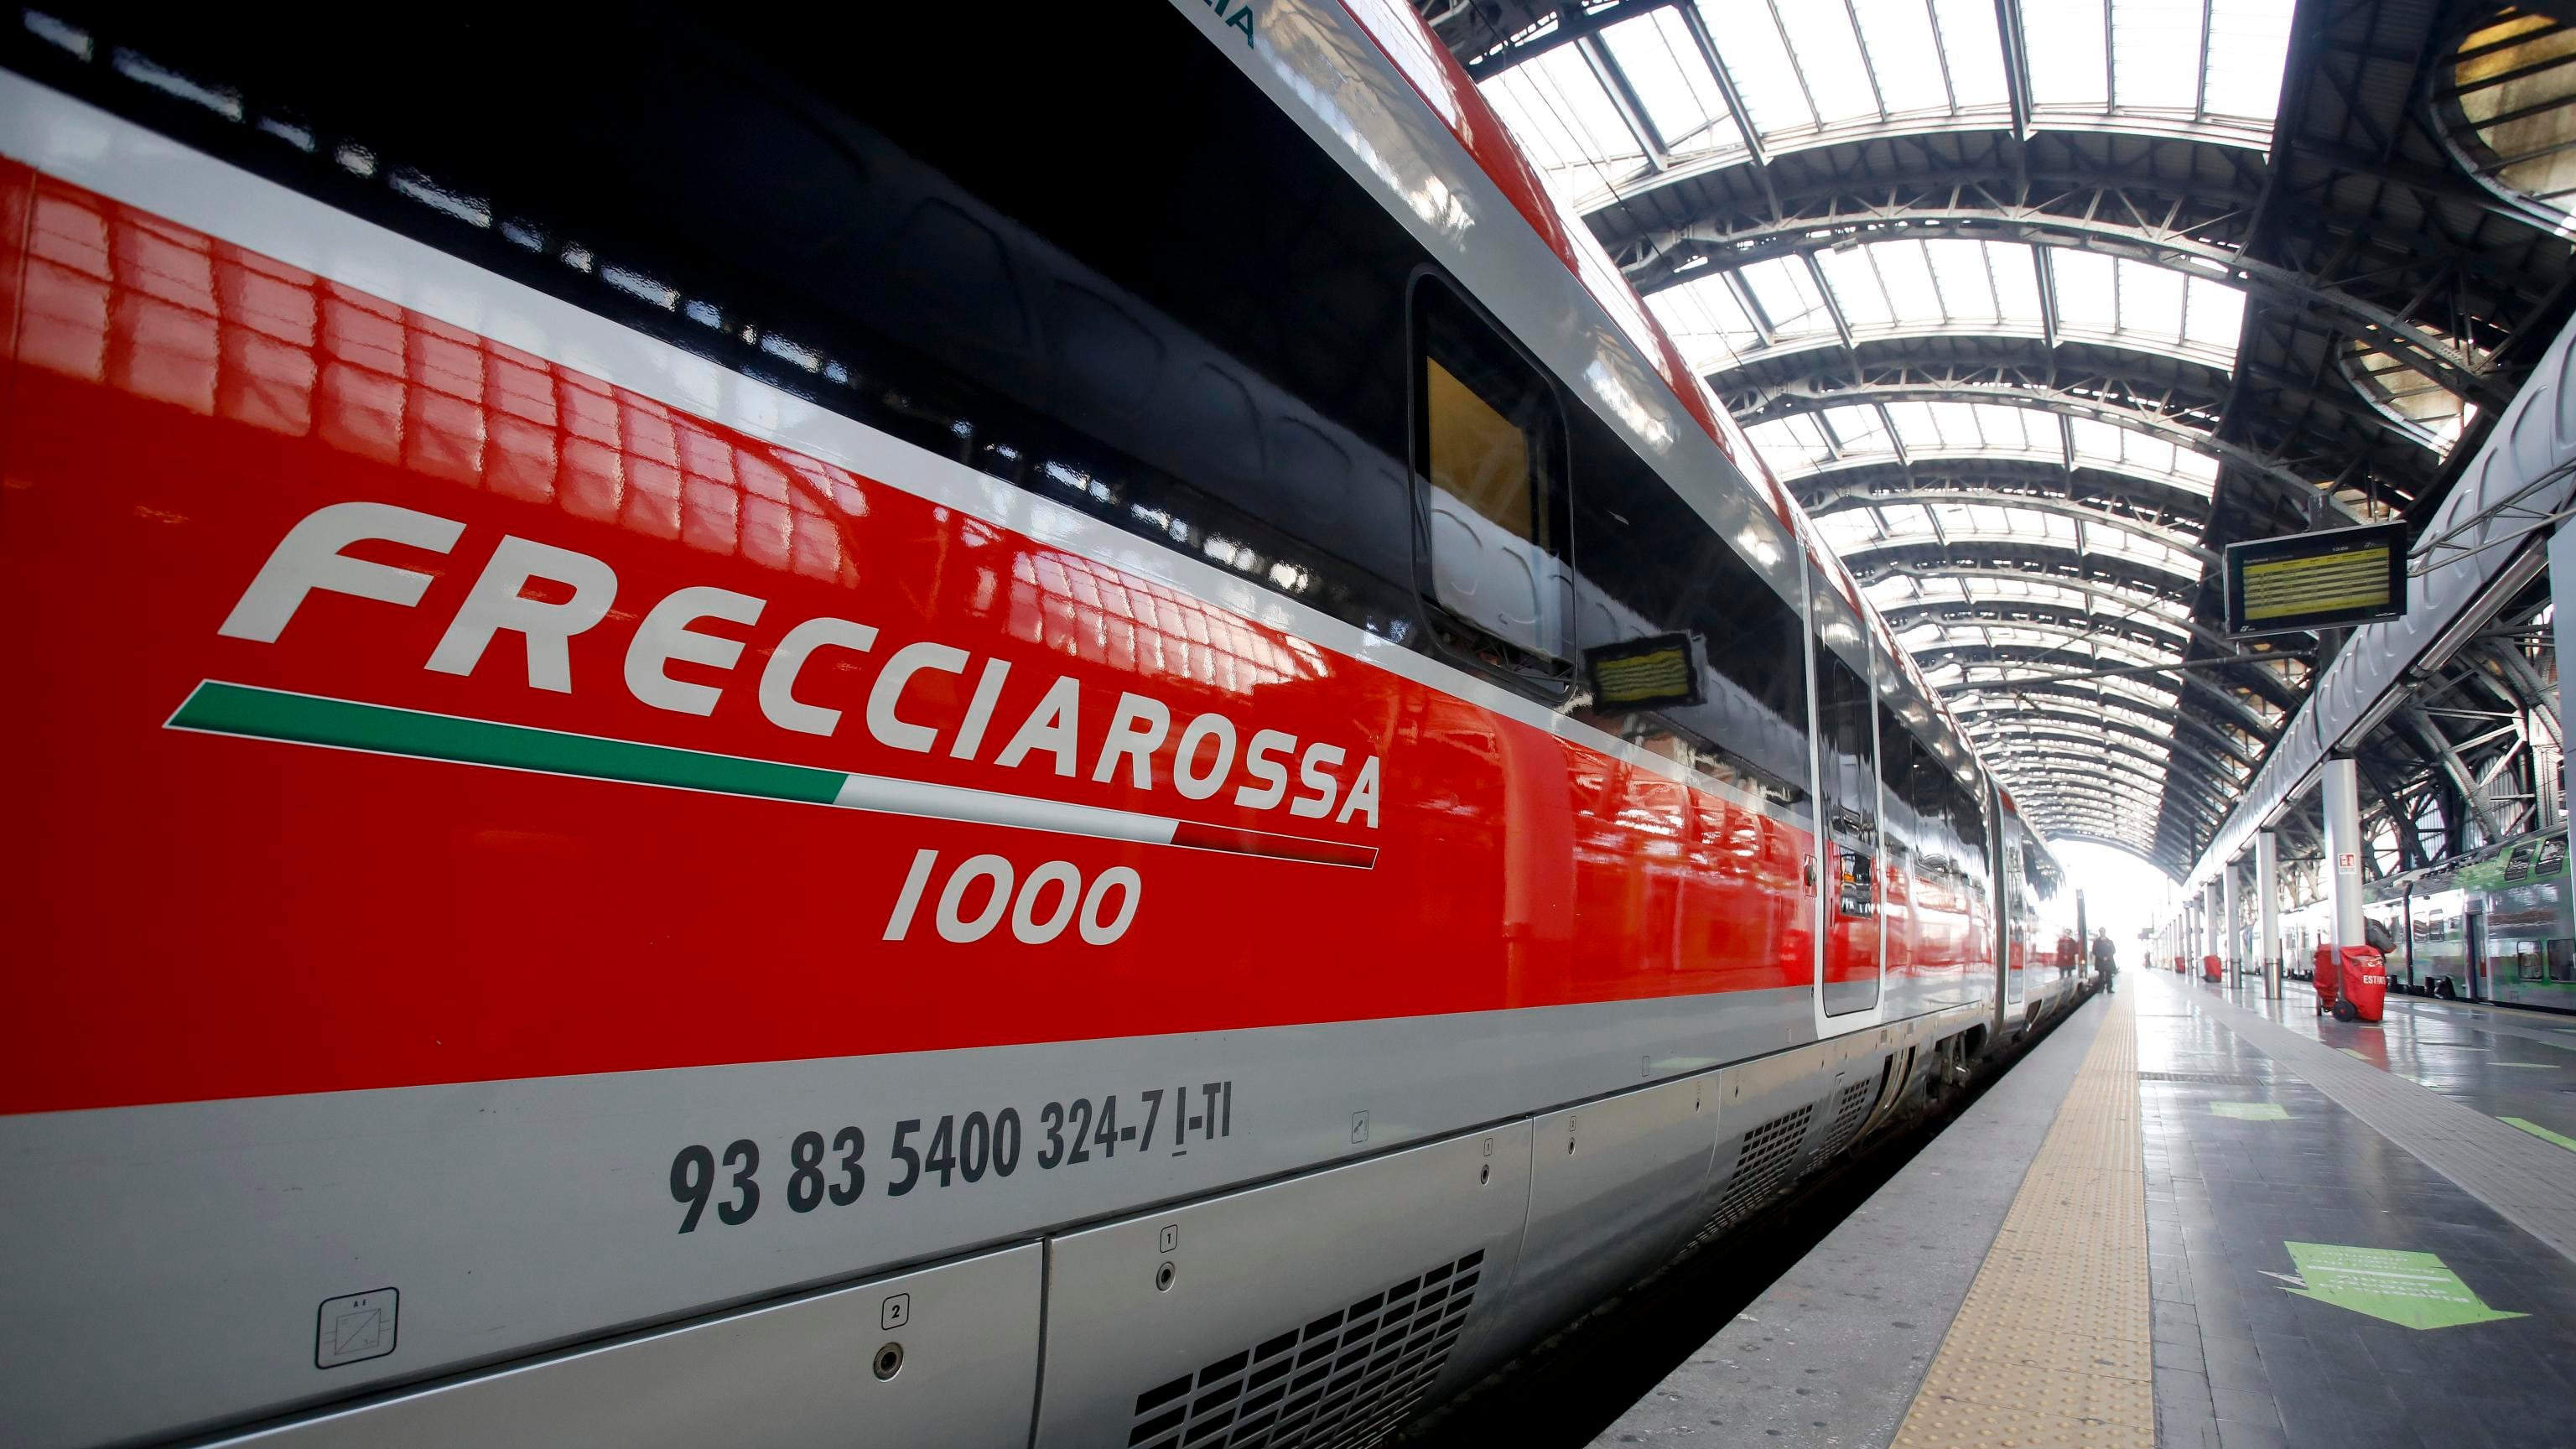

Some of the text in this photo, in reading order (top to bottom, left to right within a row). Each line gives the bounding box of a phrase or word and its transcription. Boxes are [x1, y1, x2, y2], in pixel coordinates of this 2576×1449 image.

[217, 501, 1380, 829] FRECCIAROSSA
[882, 849, 1141, 946] 1000
[669, 1081, 1232, 1235] 93 83 5400 324-7 I-TI
[1166, 1233, 1171, 1244] 1
[891, 1304, 901, 1319] 2
